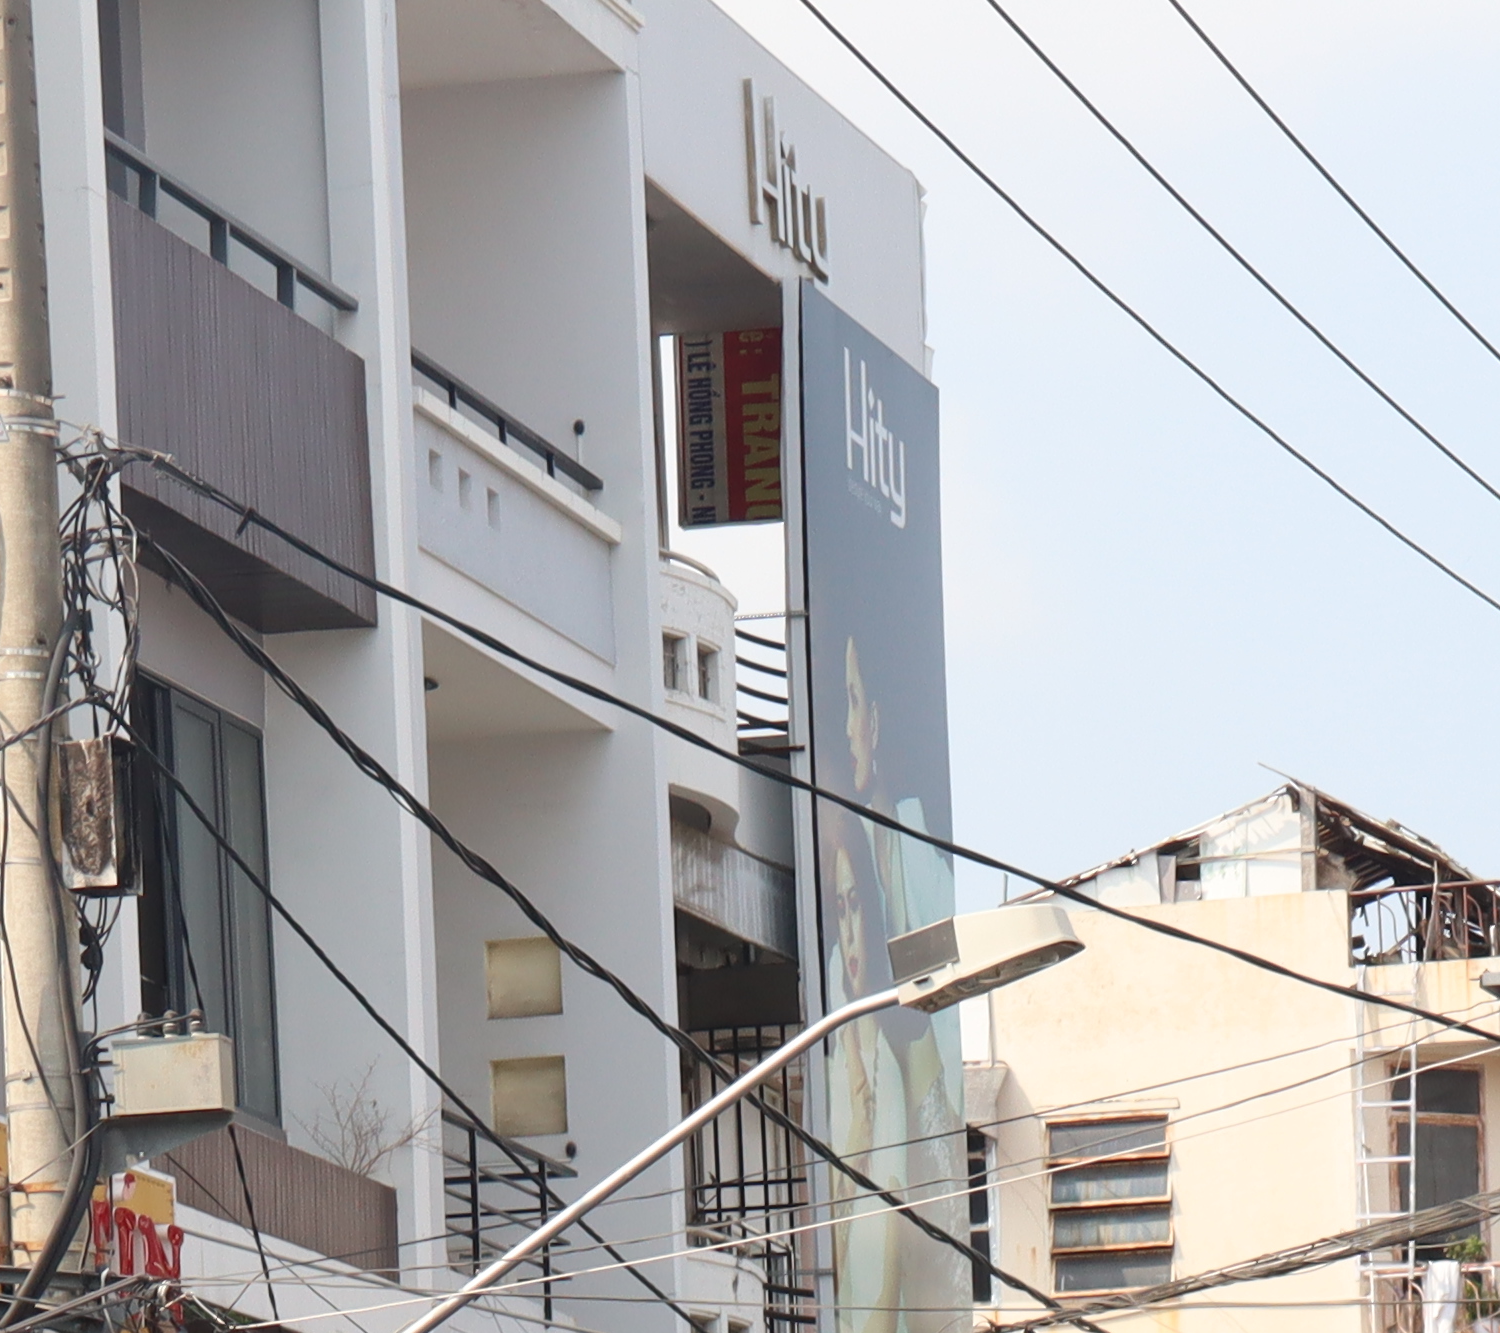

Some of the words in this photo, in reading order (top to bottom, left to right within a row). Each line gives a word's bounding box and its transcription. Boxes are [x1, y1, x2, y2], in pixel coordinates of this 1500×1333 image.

[743, 78, 829, 286] Hity
[690, 430, 715, 488] PHONG
[844, 347, 907, 529] Hity
